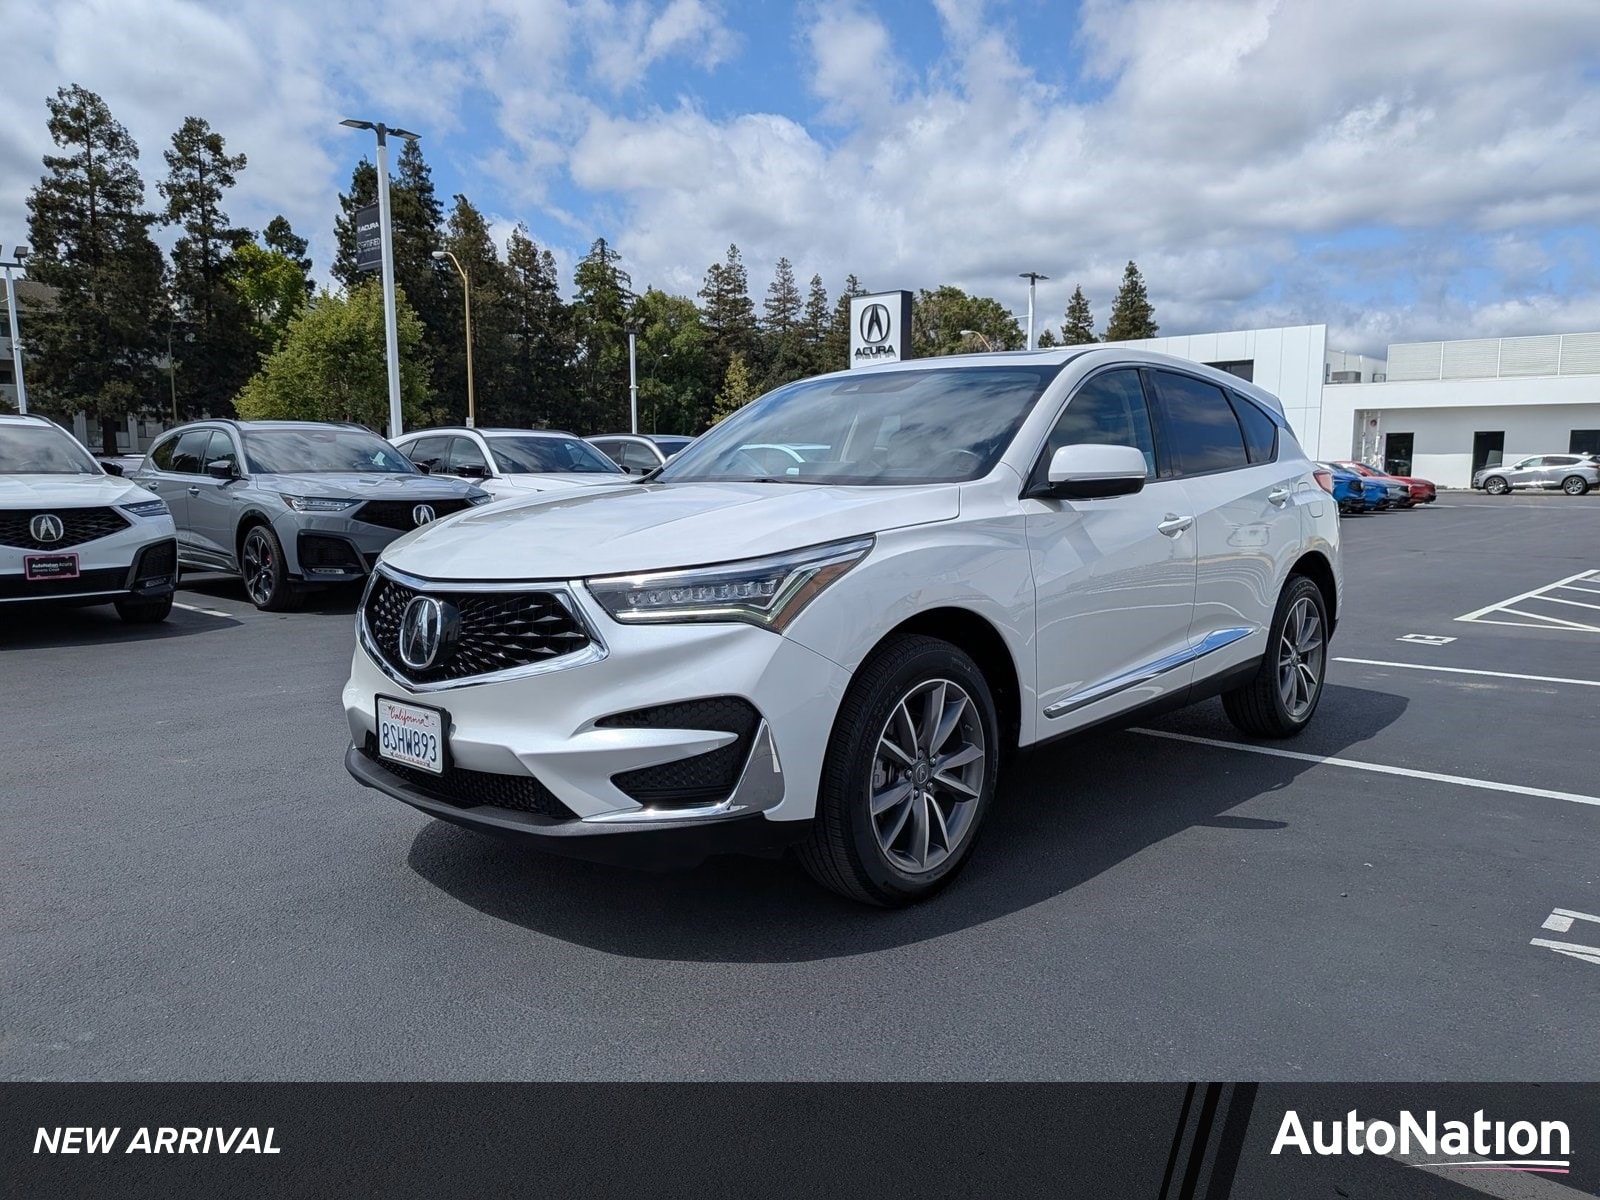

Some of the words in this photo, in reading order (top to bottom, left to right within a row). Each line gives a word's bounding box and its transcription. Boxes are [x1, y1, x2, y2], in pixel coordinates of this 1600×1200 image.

[360, 221, 379, 232] ACURA
[855, 344, 895, 356] ACURA
[391, 705, 429, 727] California
[382, 722, 437, 762] 8SHW893
